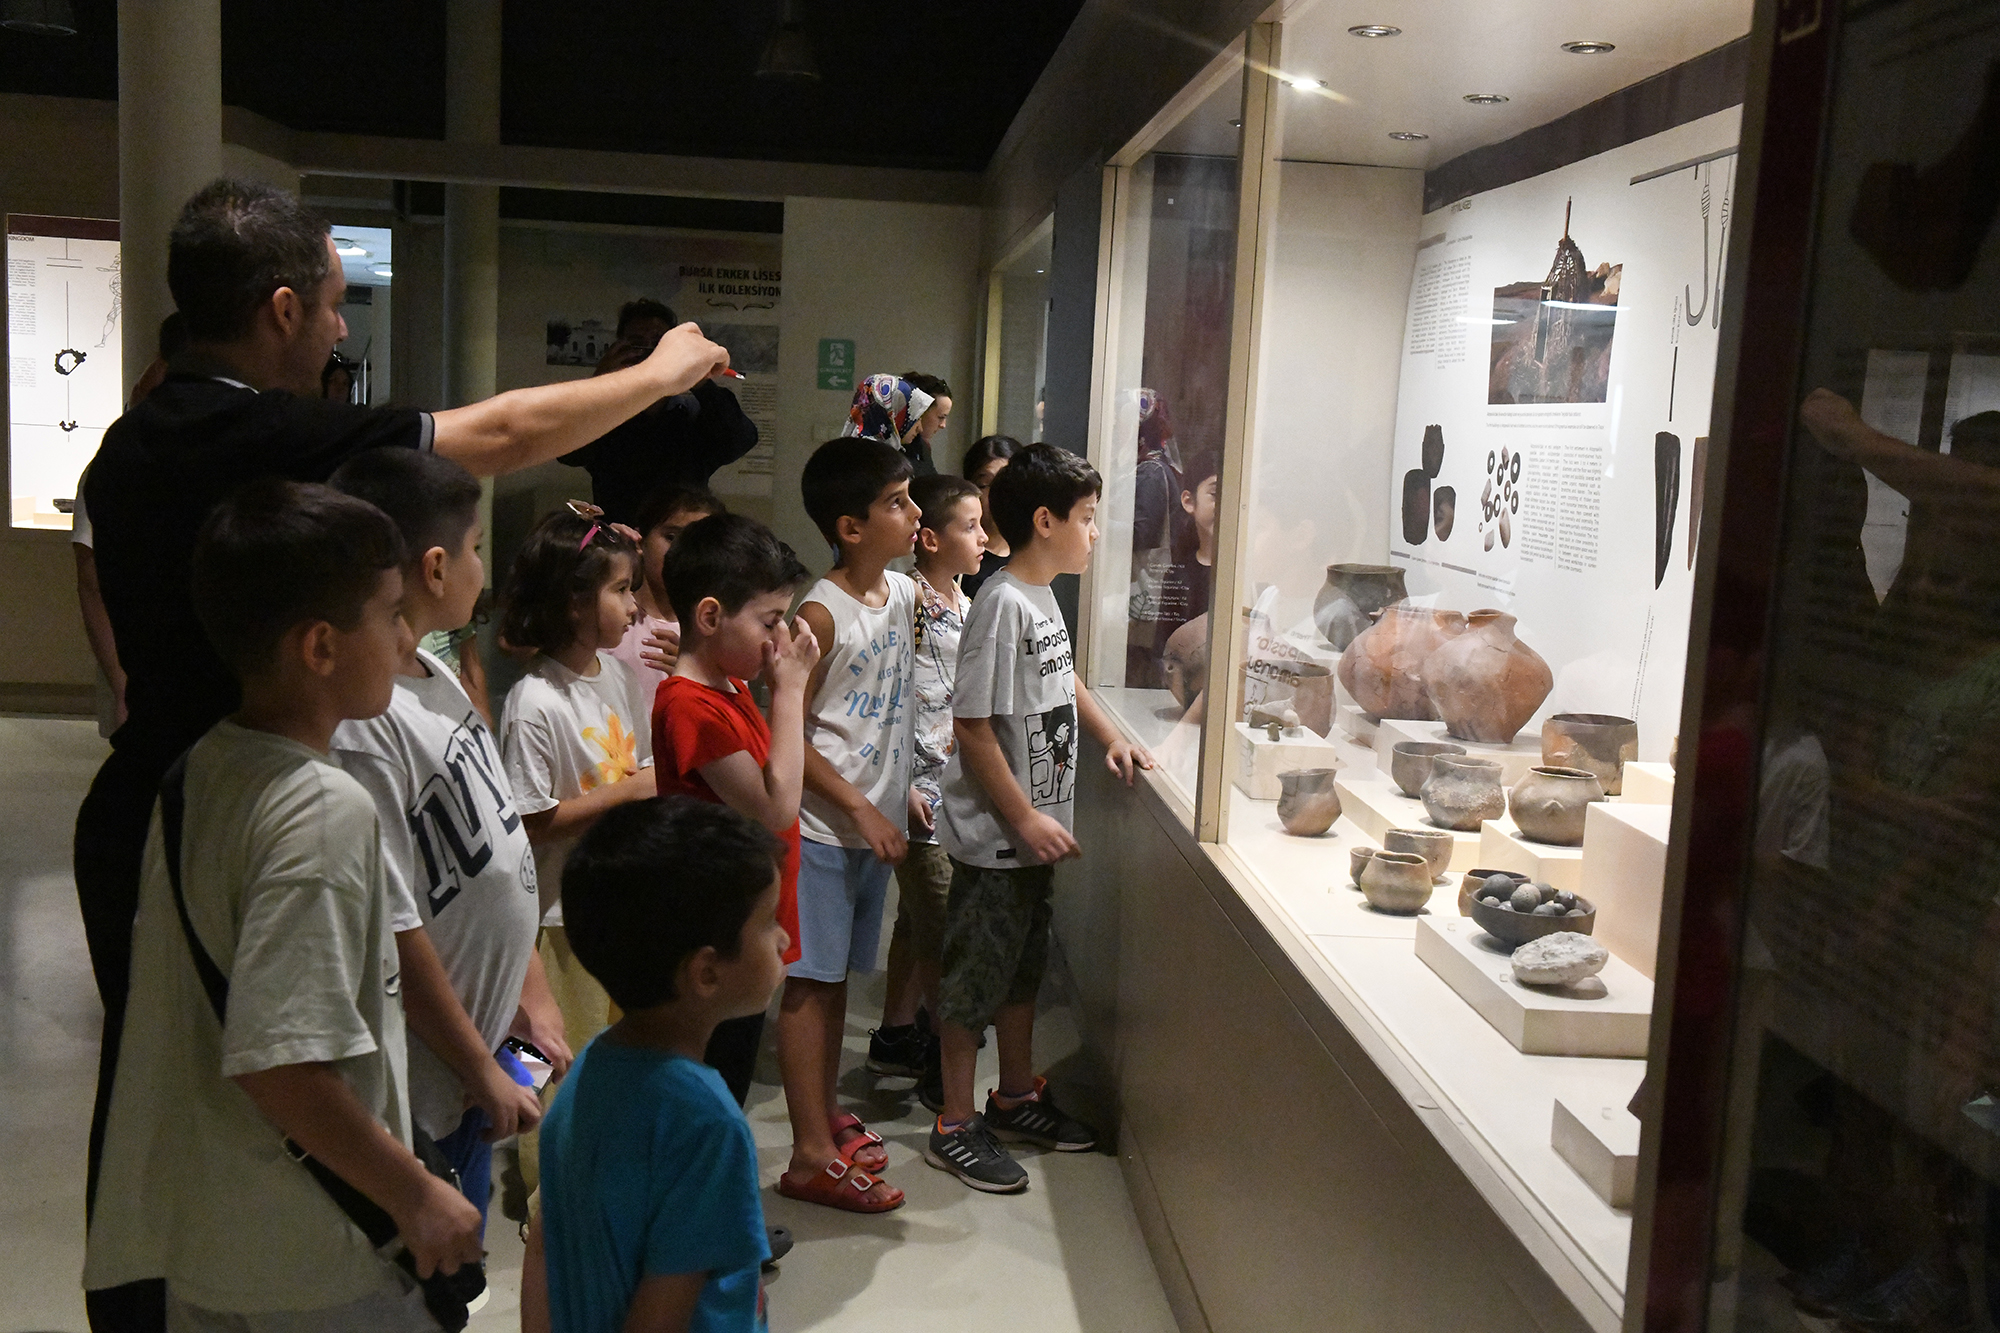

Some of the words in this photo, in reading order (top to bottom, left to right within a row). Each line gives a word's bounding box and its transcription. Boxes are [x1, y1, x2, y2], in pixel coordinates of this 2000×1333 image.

[679, 266, 713, 278] BURSA
[717, 268, 750, 280] ERKEK
[753, 267, 782, 281] LİSES
